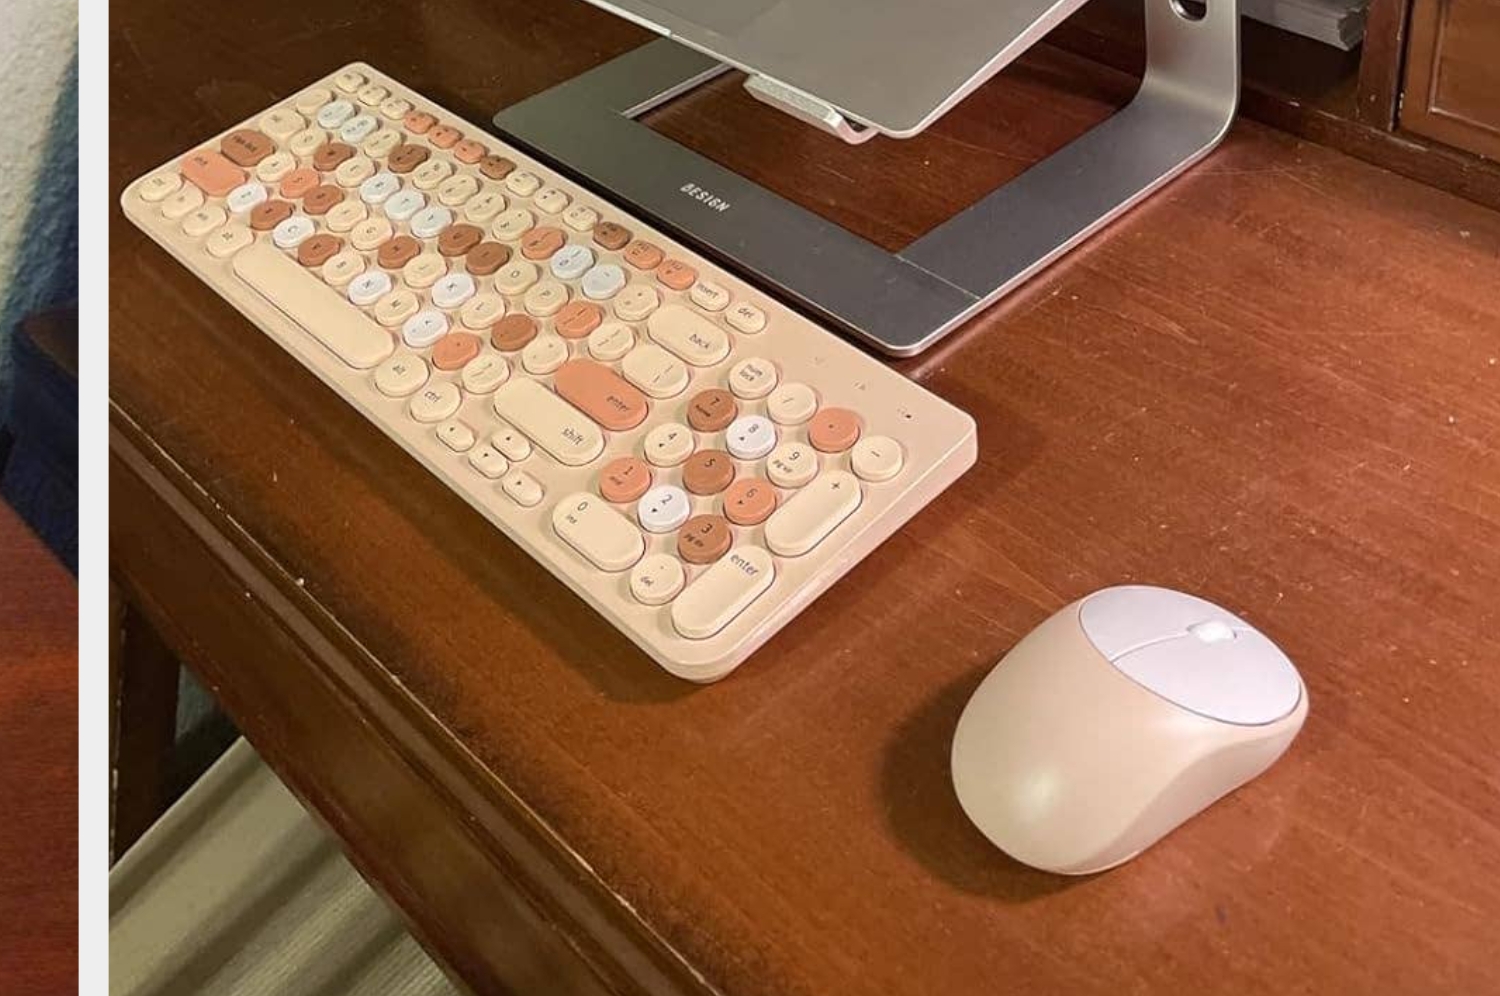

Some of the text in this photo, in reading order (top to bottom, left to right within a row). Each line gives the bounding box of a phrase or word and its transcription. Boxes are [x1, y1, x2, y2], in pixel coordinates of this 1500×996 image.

[680, 182, 731, 212] DESIGN
[606, 395, 630, 412] enter
[561, 426, 585, 446] shift
[788, 451, 800, 462] 9
[661, 494, 673, 505] 2
[701, 523, 713, 534] 3
[729, 553, 759, 577] enter
